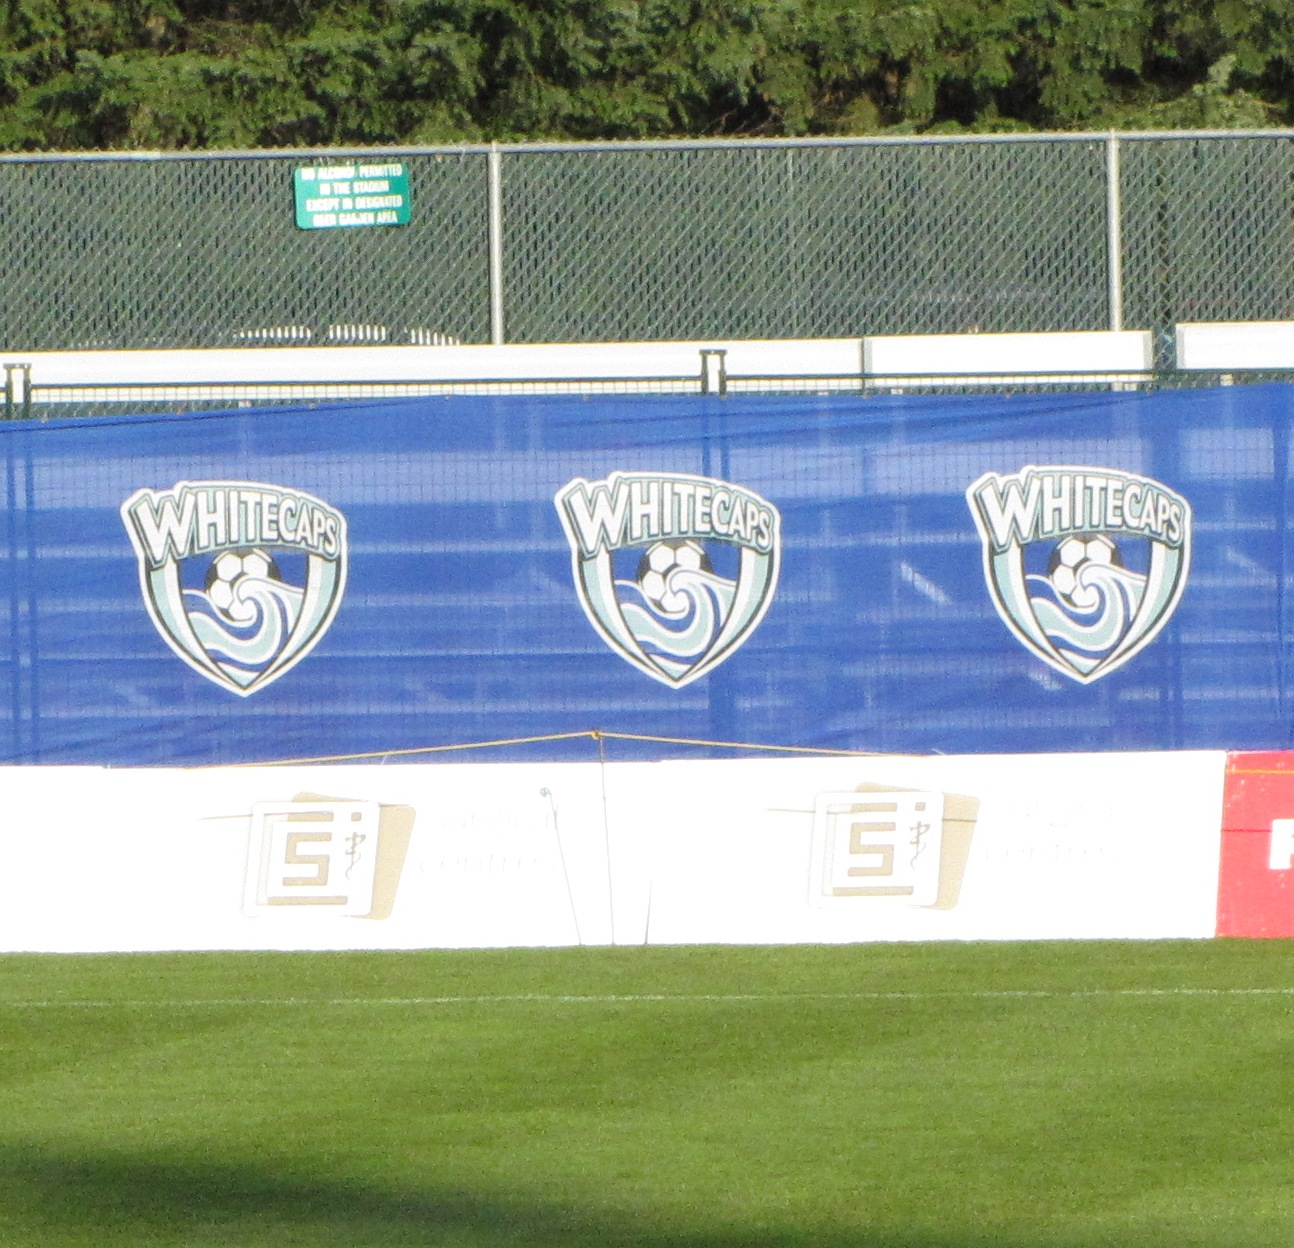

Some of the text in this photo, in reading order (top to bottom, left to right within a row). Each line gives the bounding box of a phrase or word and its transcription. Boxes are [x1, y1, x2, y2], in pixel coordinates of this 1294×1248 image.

[333, 181, 351, 195] THE
[132, 484, 339, 562] WHITECAPS
[566, 478, 770, 553] WHITECAPS
[982, 473, 1185, 546] WHITECAPS
